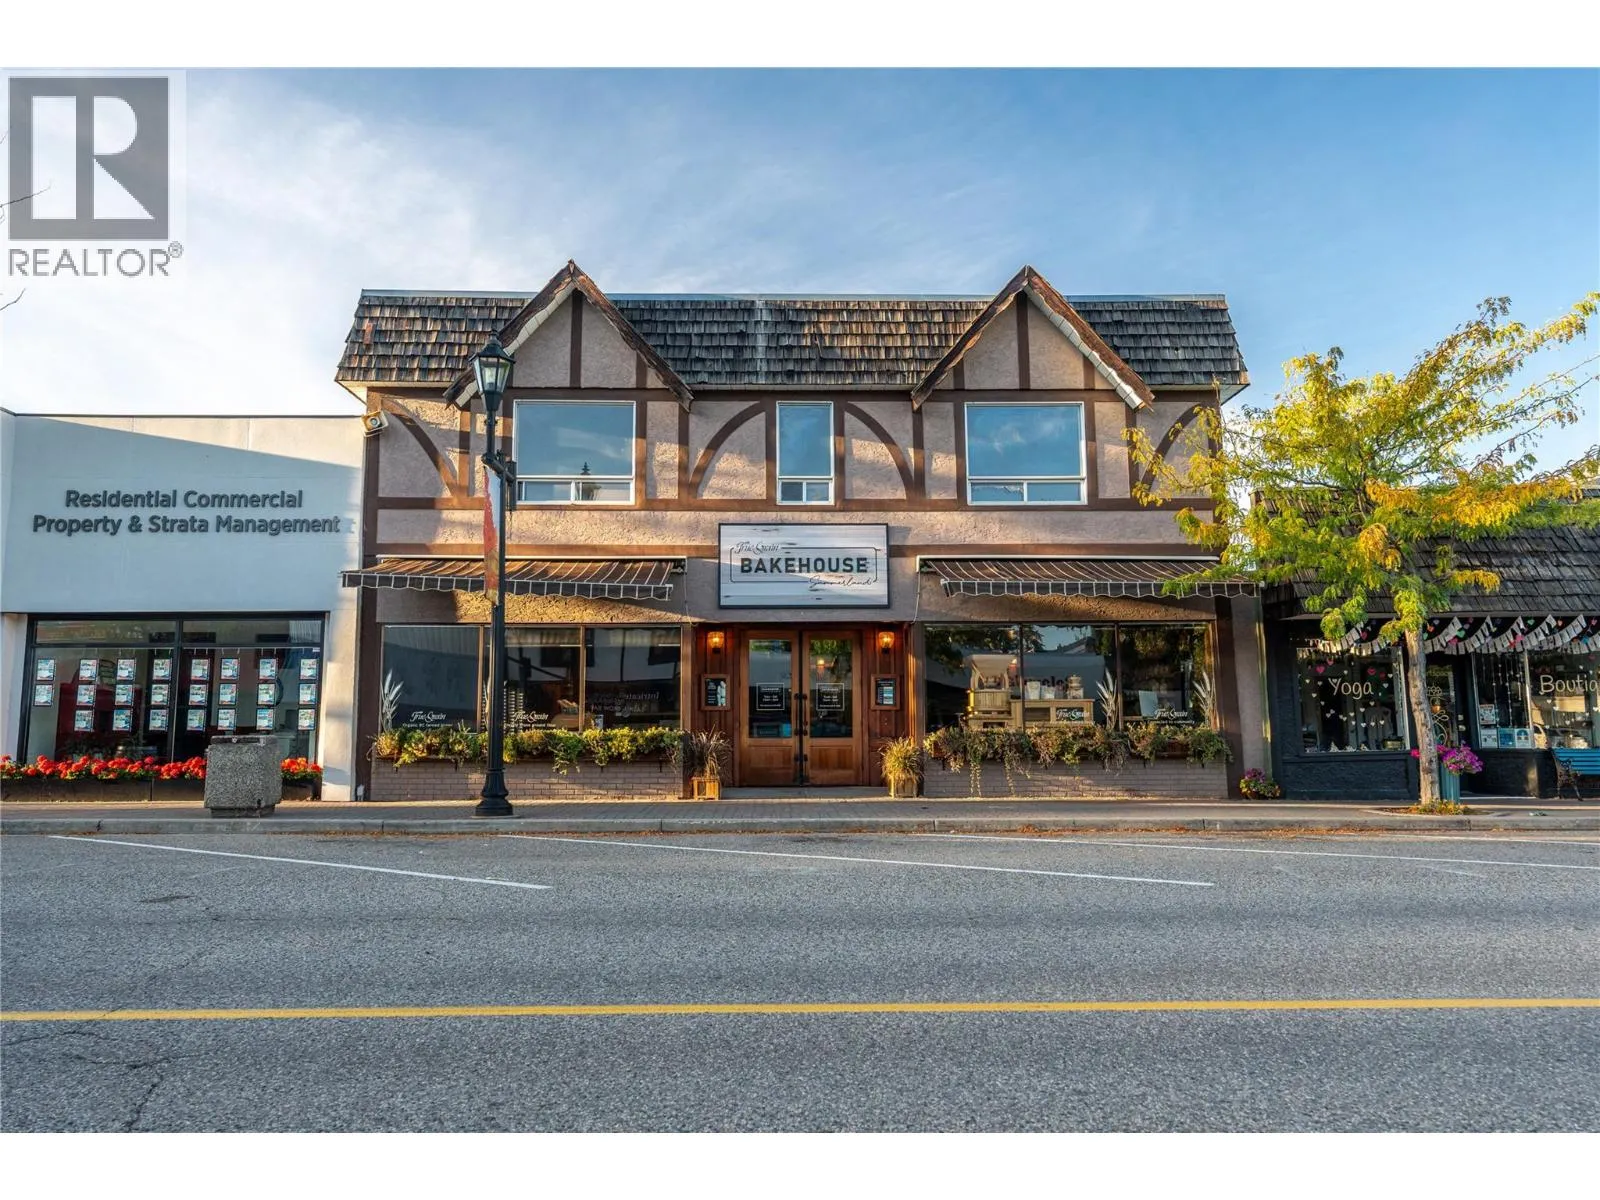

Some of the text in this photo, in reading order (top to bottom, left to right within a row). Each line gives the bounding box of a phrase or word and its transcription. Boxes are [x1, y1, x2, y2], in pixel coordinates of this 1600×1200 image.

[65, 489, 303, 508] Residential Commercial
[33, 514, 341, 537] Property & Strata Management
[740, 557, 868, 573] BAKEHOUSE
[1328, 677, 1375, 700] Yoga
